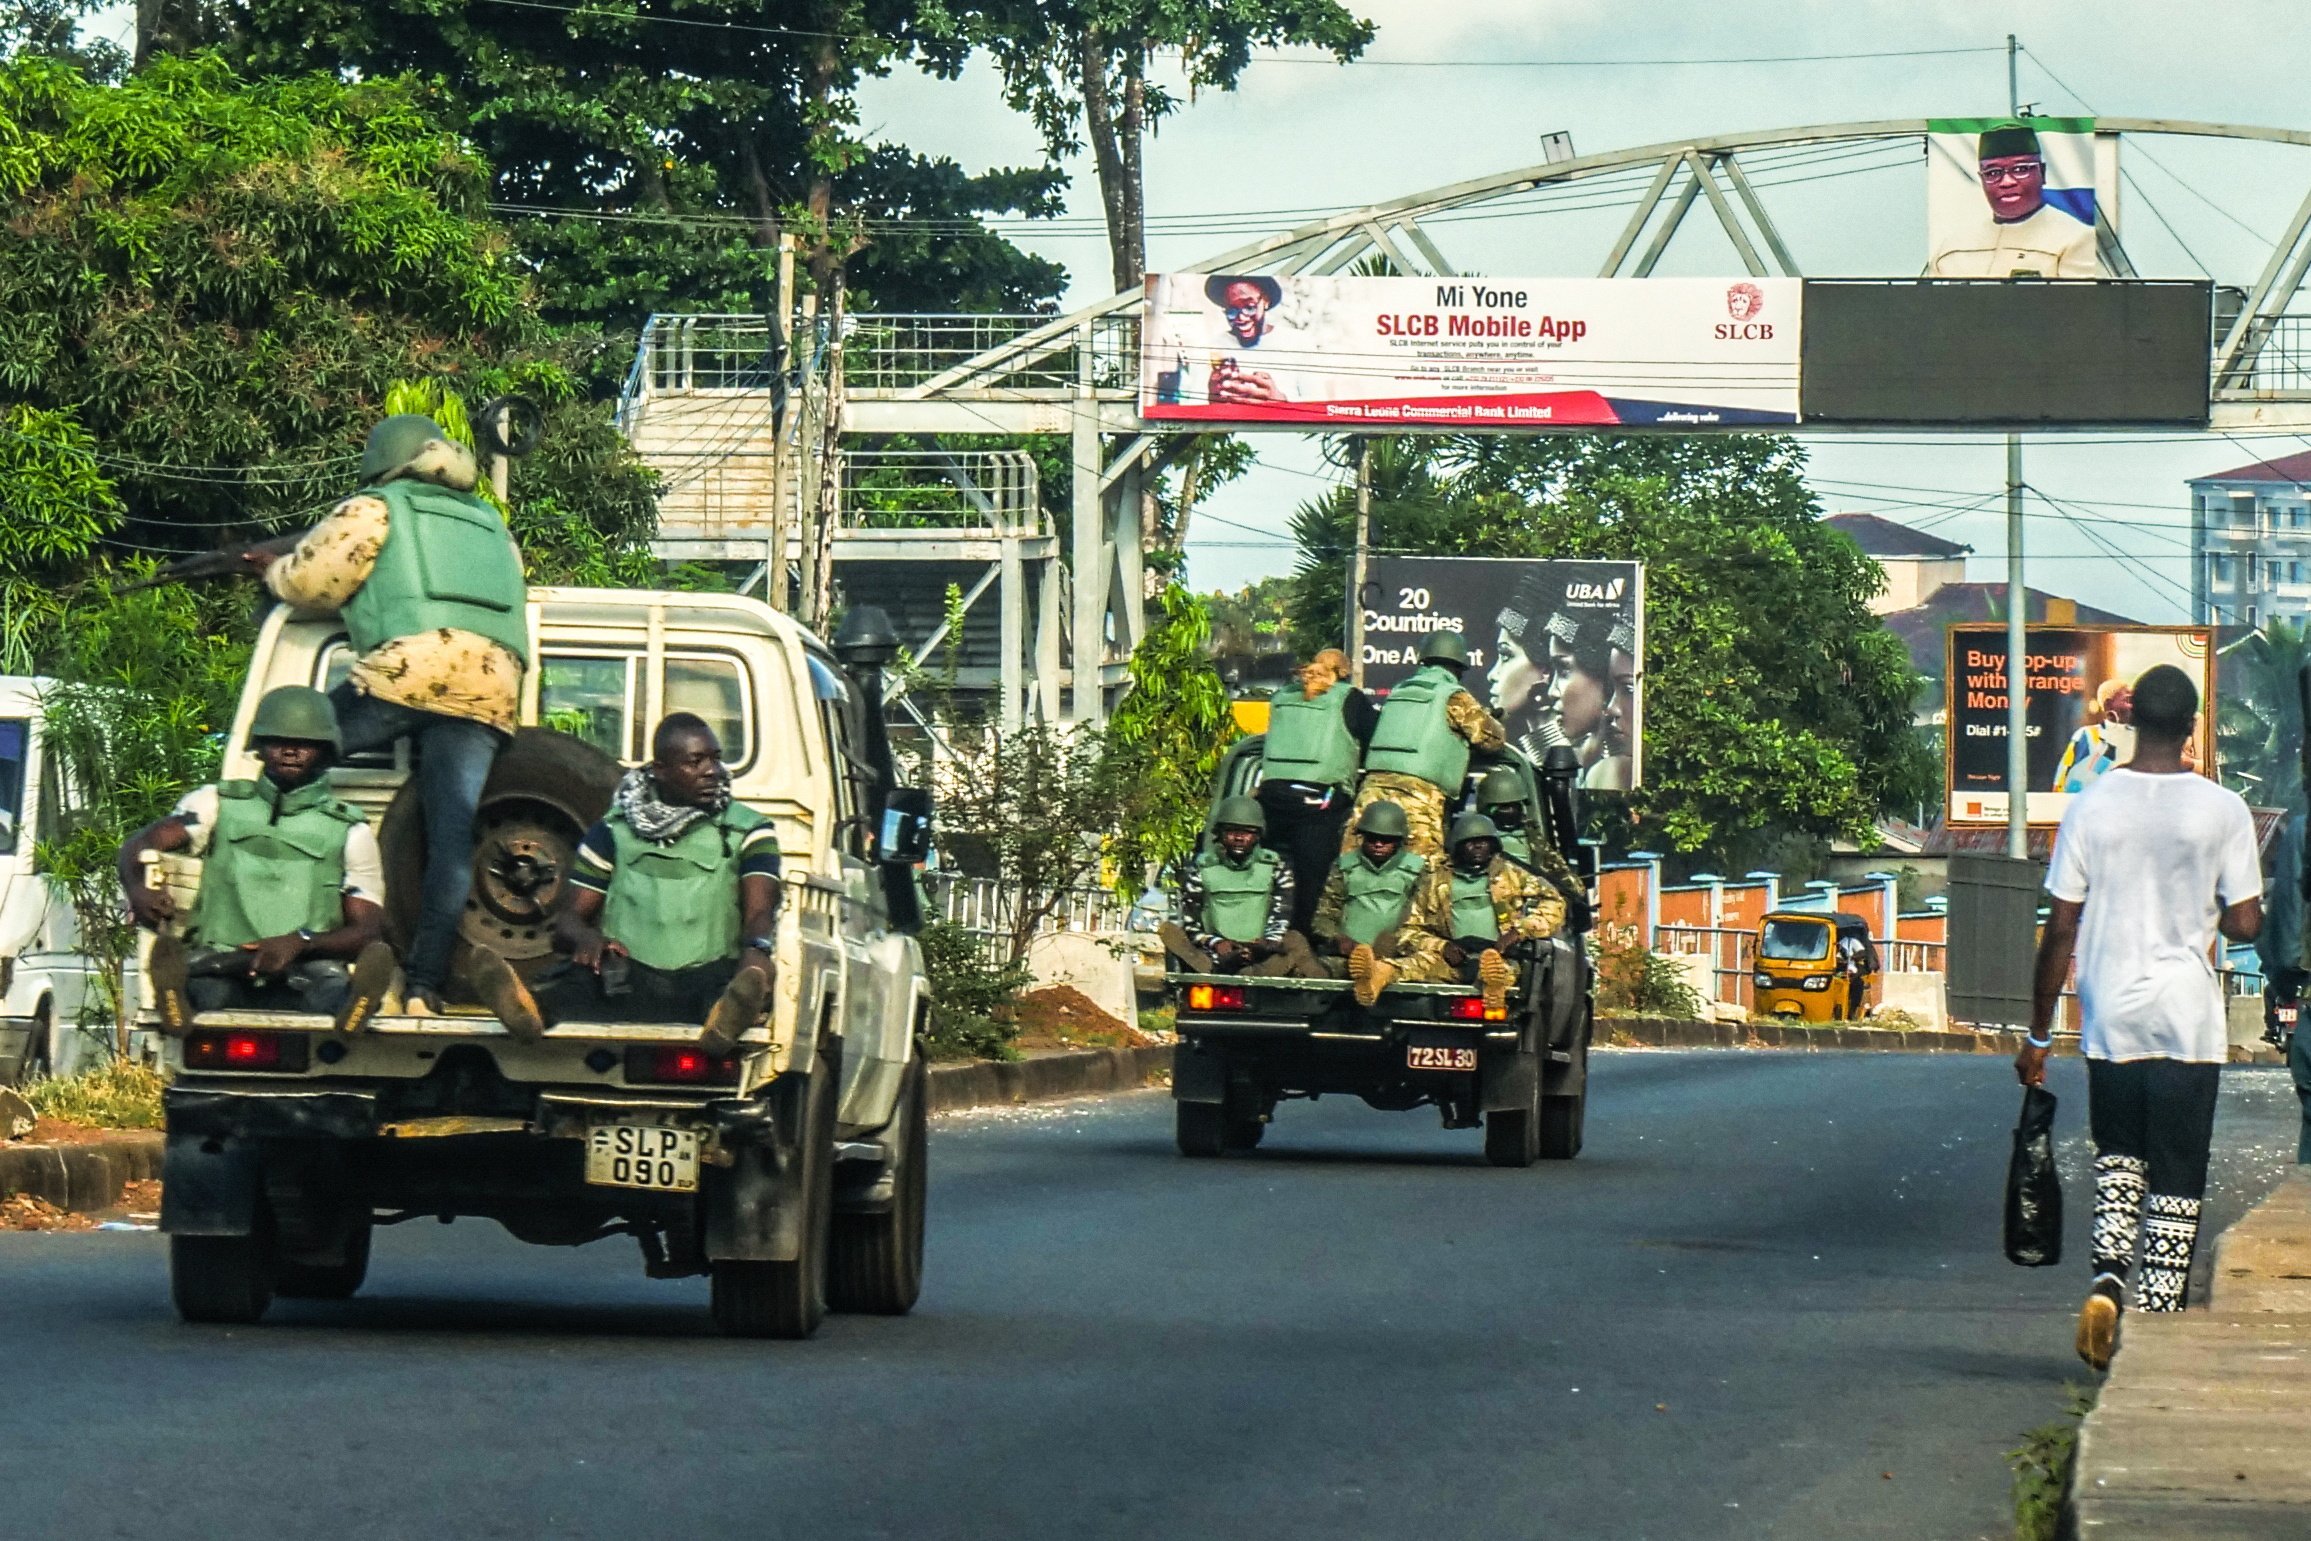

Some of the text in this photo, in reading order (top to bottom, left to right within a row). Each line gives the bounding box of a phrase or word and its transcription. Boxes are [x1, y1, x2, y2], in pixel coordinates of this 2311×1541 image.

[1437, 286, 1528, 308] Mi Yone
[1377, 315, 1586, 342] SLCB Mobile App
[1714, 323, 1774, 340] SLCB
[1390, 339, 1408, 347] SLCB
[1326, 404, 1362, 417] Sierra
[1507, 406, 1552, 419] Limited
[1399, 587, 1430, 610] 20
[1566, 583, 1604, 599] UBA
[1363, 609, 1464, 633] Countries
[1362, 644, 1401, 664] One
[1967, 650, 2078, 672] Buy op-up
[1967, 672, 2087, 694] with range
[1967, 691, 2032, 711] Mony
[1966, 724, 1991, 736] Dial
[615, 1127, 678, 1159] SLP
[613, 1157, 675, 1187] 090
